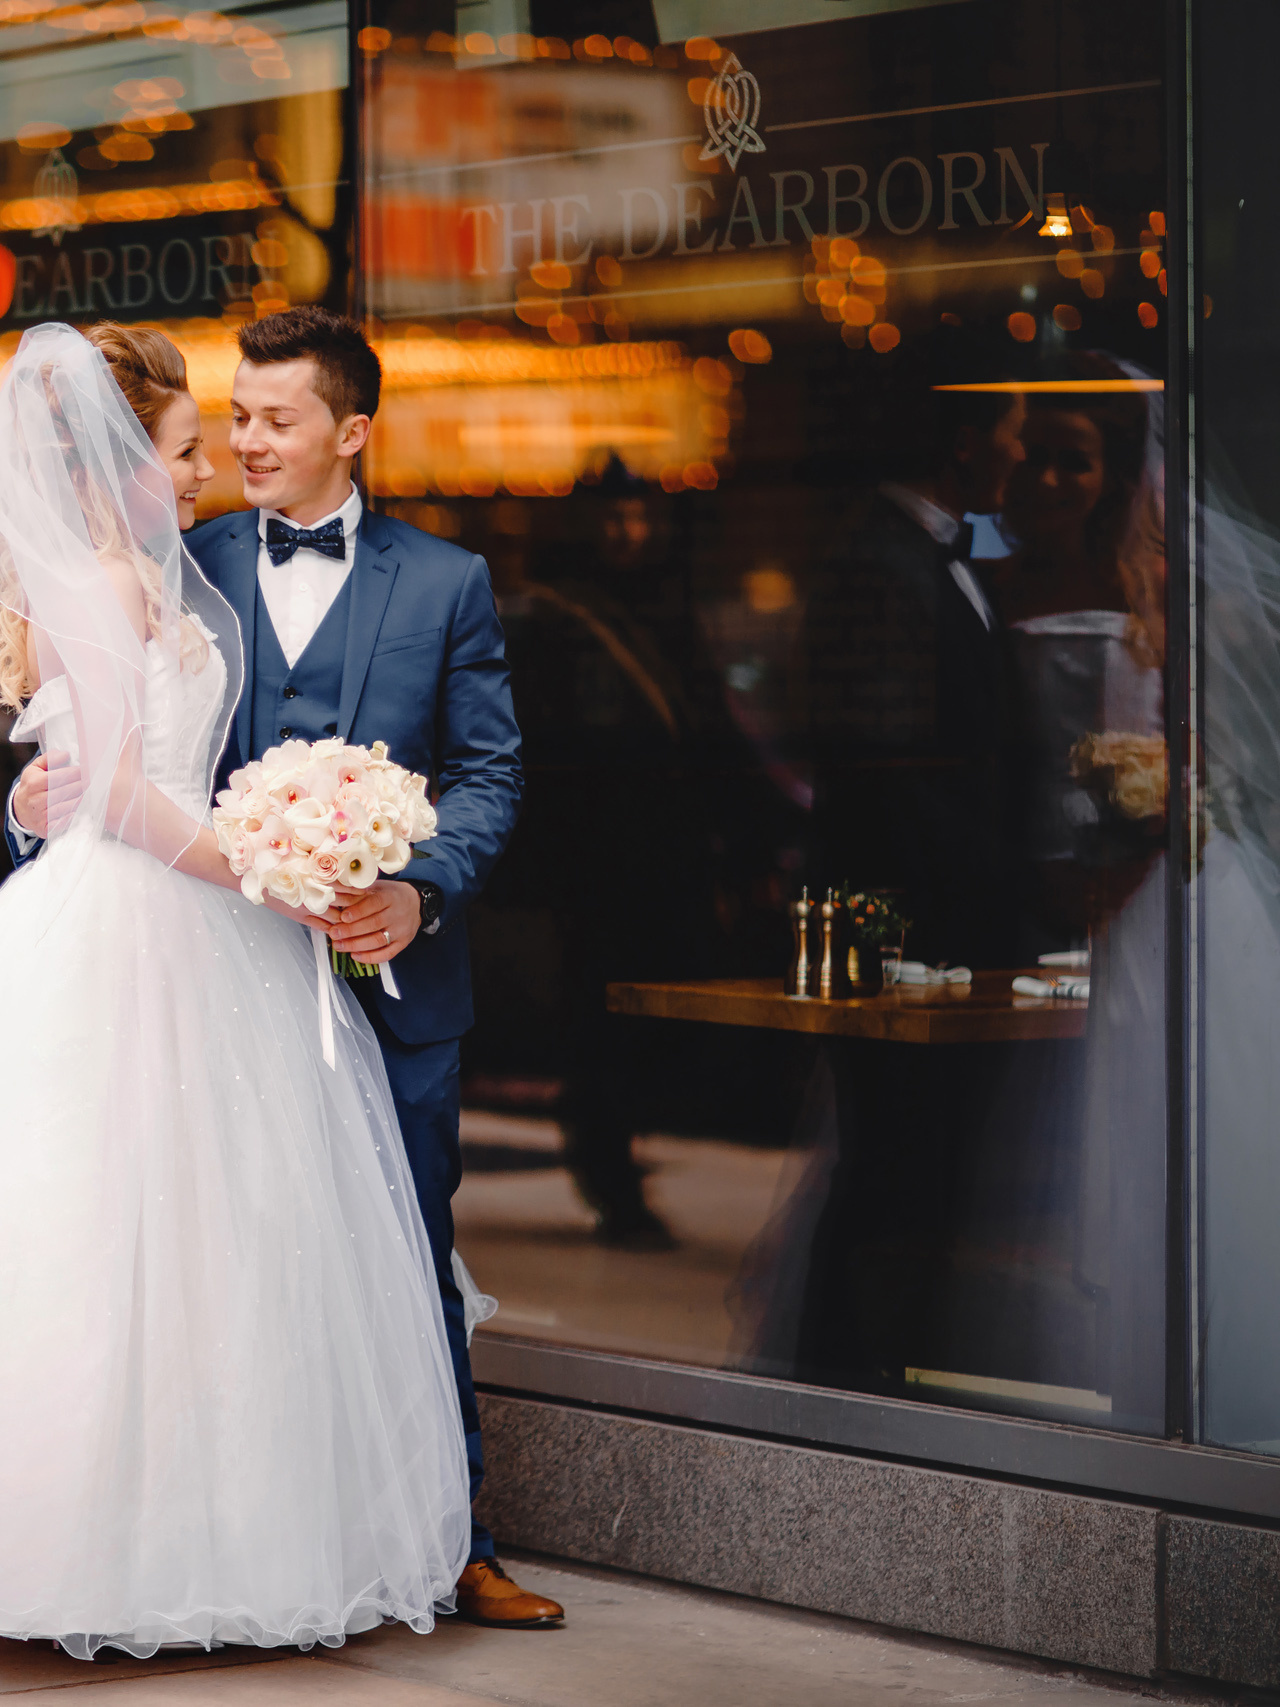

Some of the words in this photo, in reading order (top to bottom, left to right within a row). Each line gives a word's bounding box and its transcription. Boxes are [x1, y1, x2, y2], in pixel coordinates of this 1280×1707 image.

[461, 193, 595, 276] THE
[617, 143, 1050, 262] DEARBORN
[12, 231, 279, 318] EARBORN
